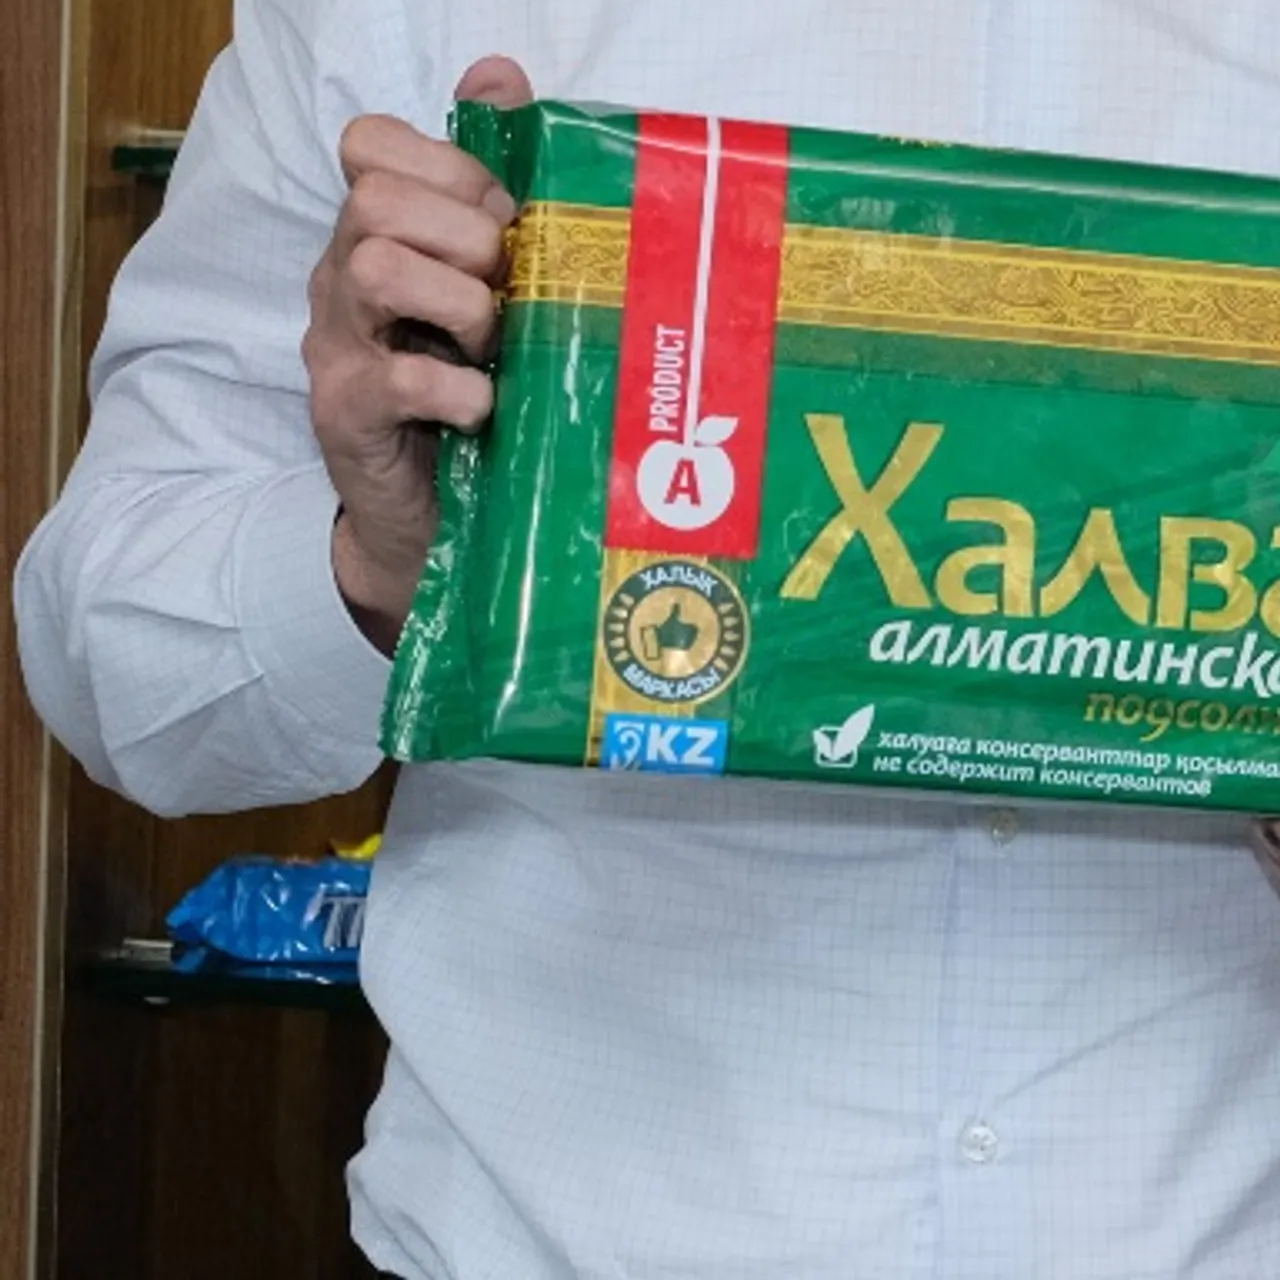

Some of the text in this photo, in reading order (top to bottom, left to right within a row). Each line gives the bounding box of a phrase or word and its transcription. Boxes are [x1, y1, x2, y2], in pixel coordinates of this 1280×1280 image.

[649, 324, 688, 433] PRODUCT
[662, 458, 702, 508] A
[645, 722, 720, 766] KZ
[872, 754, 1213, 798] не содержит консервантов
